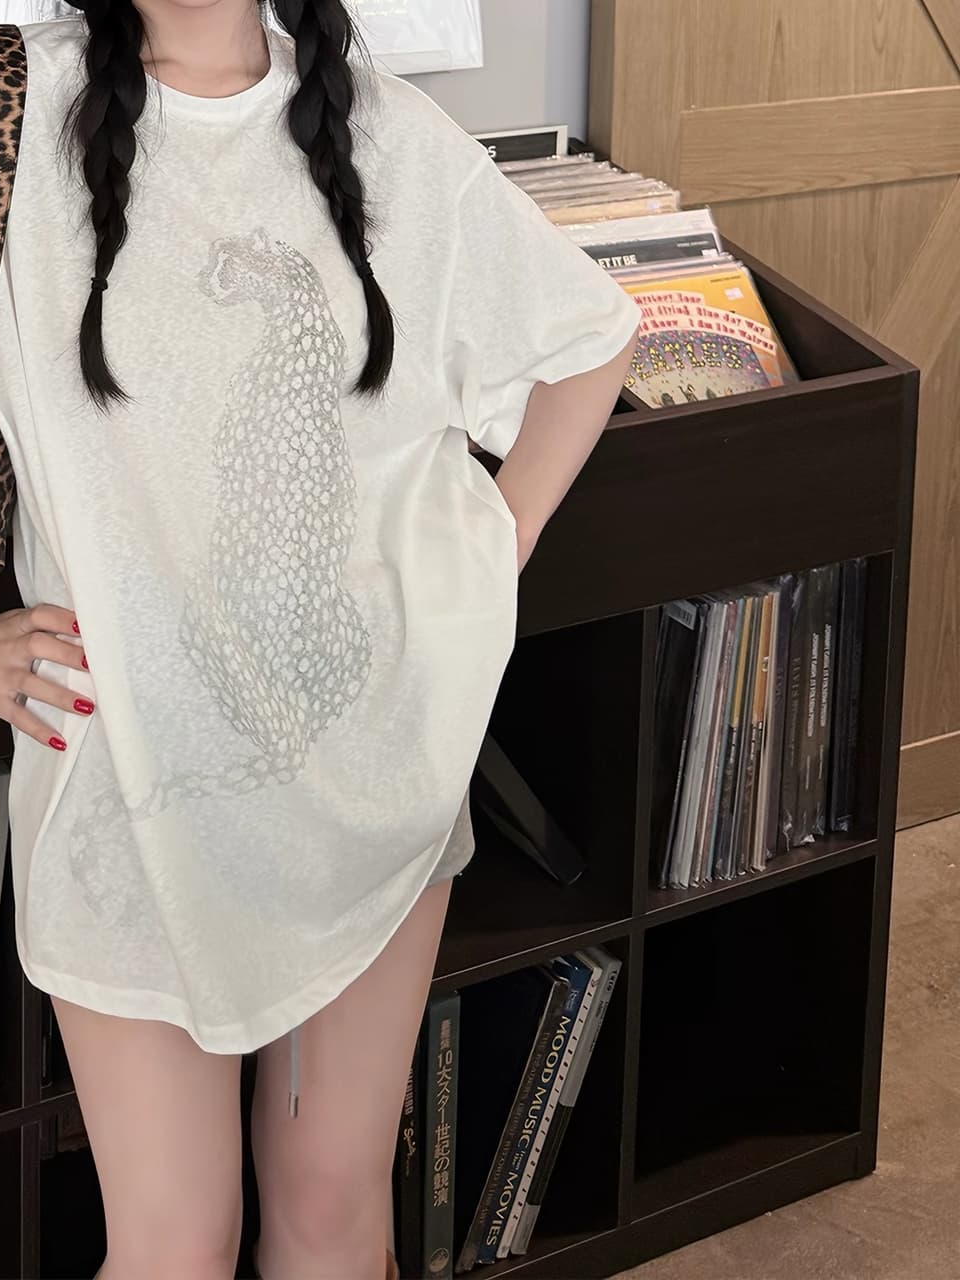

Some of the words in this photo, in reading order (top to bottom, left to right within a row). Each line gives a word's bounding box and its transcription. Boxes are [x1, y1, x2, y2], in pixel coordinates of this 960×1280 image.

[612, 256, 622, 268] IT
[623, 254, 638, 266] BE
[738, 327, 775, 351] Walrus
[745, 320, 765, 333] Way
[541, 1016, 571, 1083] MOOD
[518, 1086, 547, 1148] MUSIC
[486, 1171, 517, 1246] MOVIES
